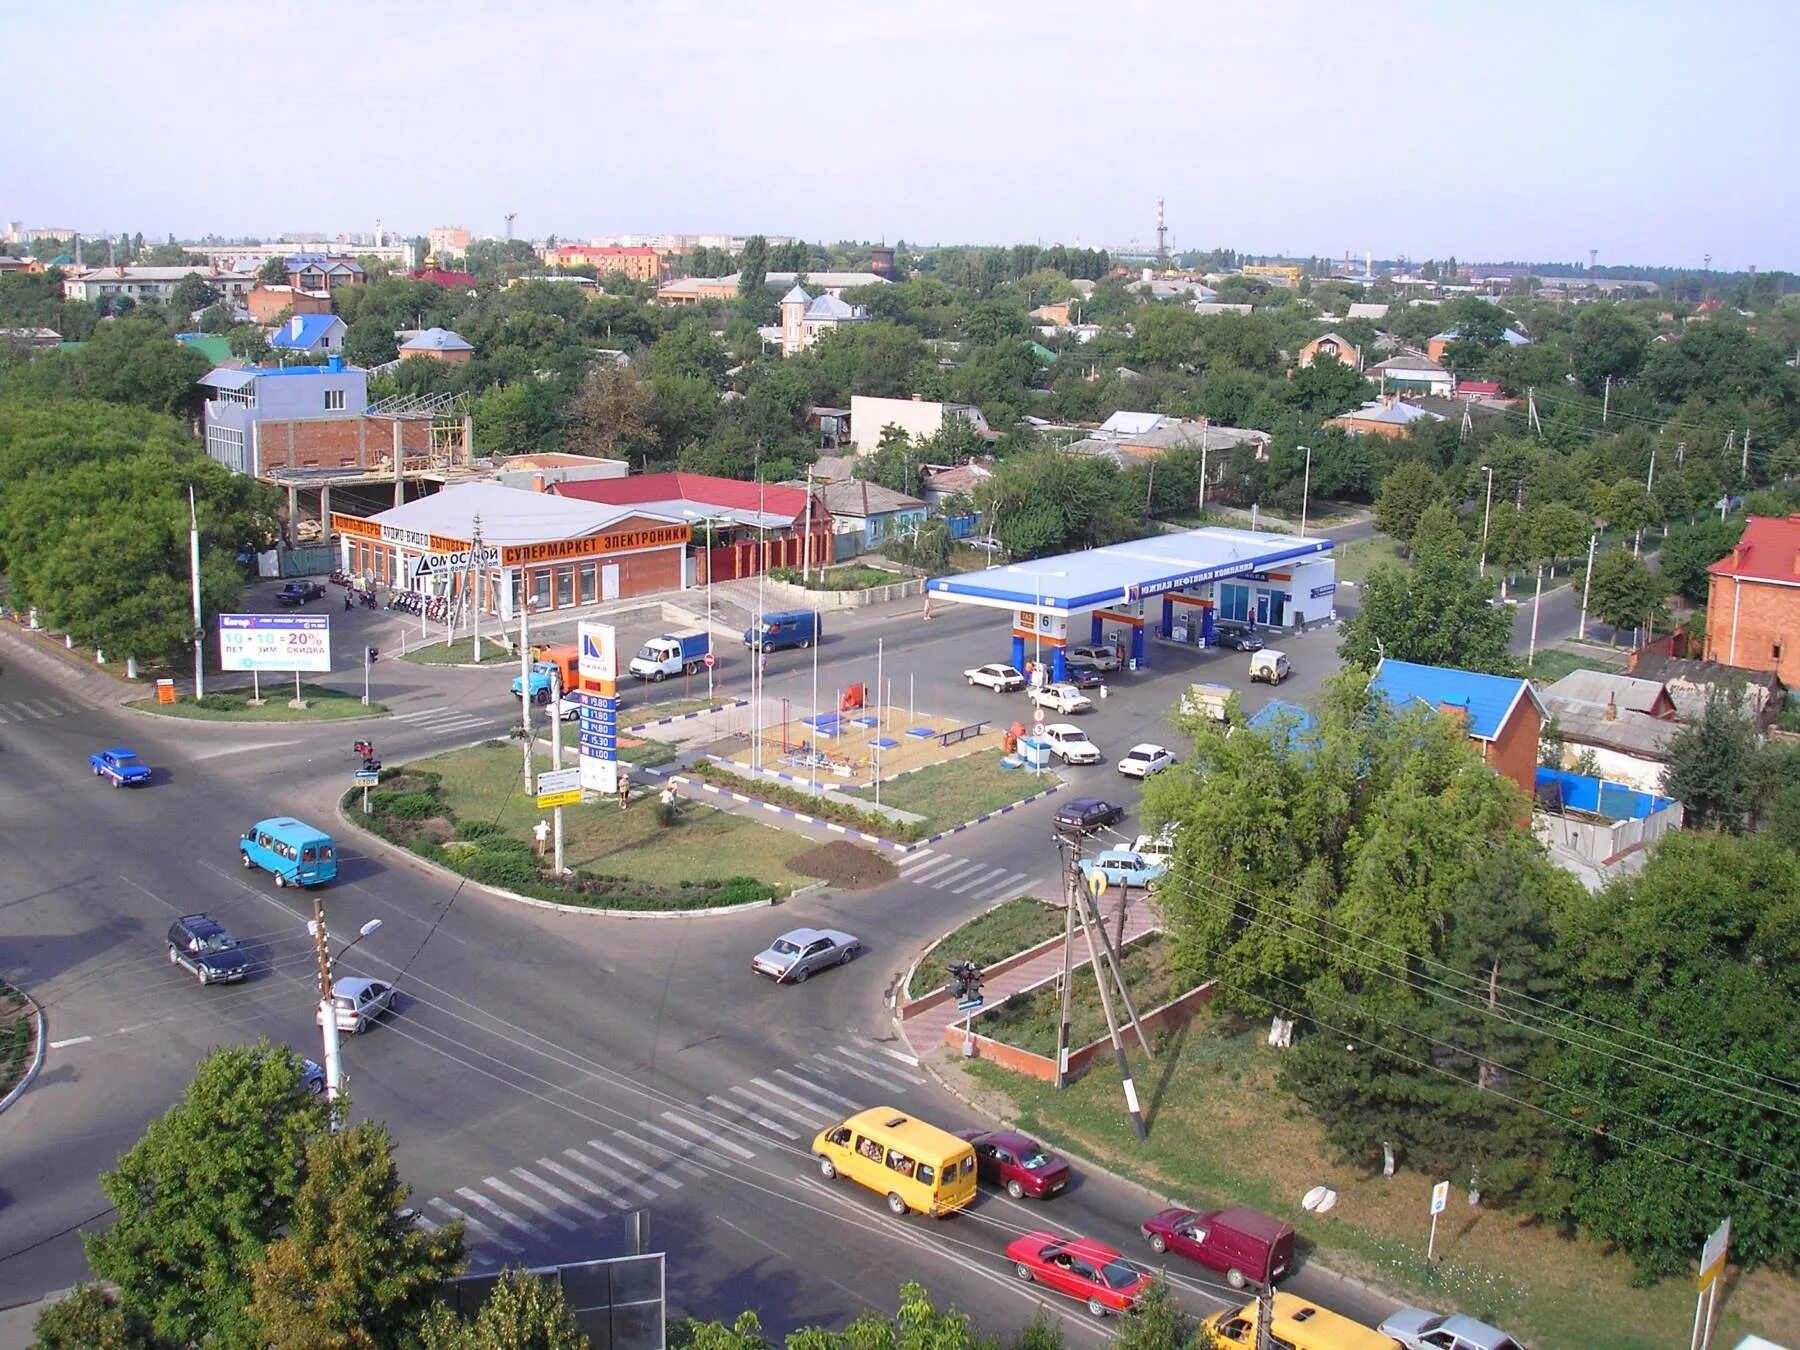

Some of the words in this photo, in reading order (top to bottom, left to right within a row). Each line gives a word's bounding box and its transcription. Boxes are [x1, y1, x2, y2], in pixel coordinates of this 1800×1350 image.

[336, 515, 381, 535] КОМПЬЮТЕРЫ
[383, 526, 429, 546] АУДИО-ВИДЕО
[430, 535, 465, 552] БЫТОВАЯ
[506, 538, 596, 562] СУПЕРМАРКЕТ
[604, 527, 688, 549] ЭЛЕКТРОНИКИ
[1141, 581, 1172, 595] ЮЖНАЯ
[1174, 570, 1214, 587] НЕФТЯНАЯ
[1214, 562, 1254, 578] КОМПАНИЯ
[1042, 615, 1049, 627] 6
[225, 633, 243, 644] 10
[257, 633, 274, 644] 10
[288, 632, 323, 645] 20%
[287, 646, 325, 654] СКИДКА
